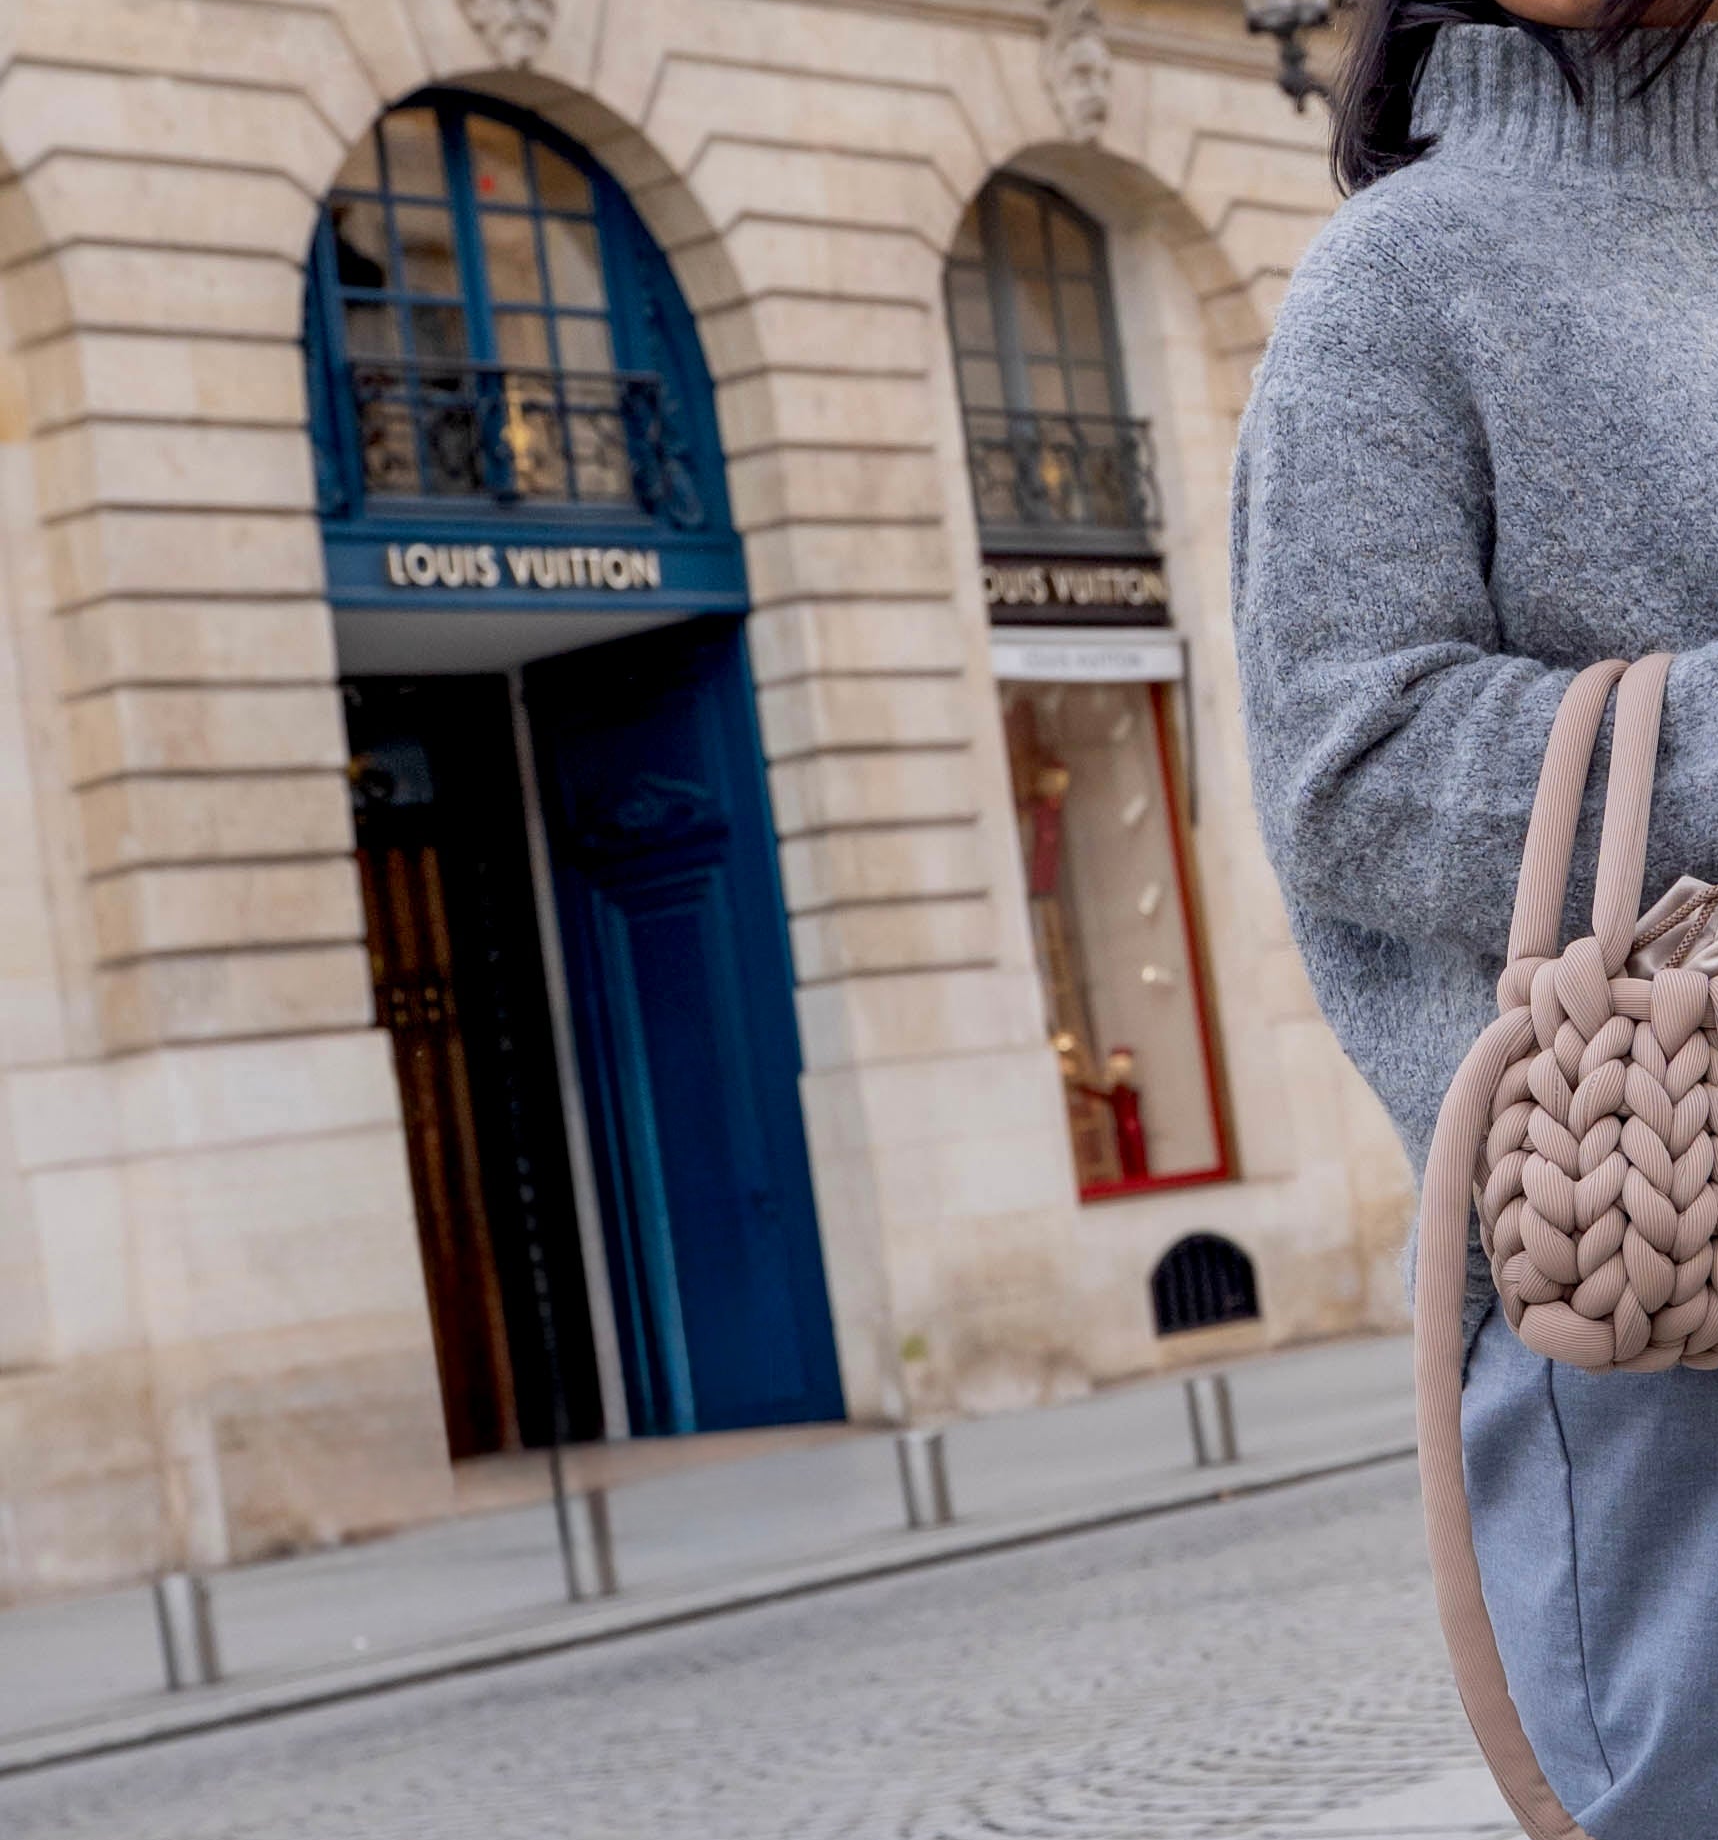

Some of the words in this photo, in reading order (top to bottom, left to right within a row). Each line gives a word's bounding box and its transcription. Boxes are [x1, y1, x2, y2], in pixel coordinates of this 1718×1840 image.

[387, 542, 501, 588] LOUIS
[505, 546, 662, 590] VUITTON
[980, 565, 1049, 605] OUIS
